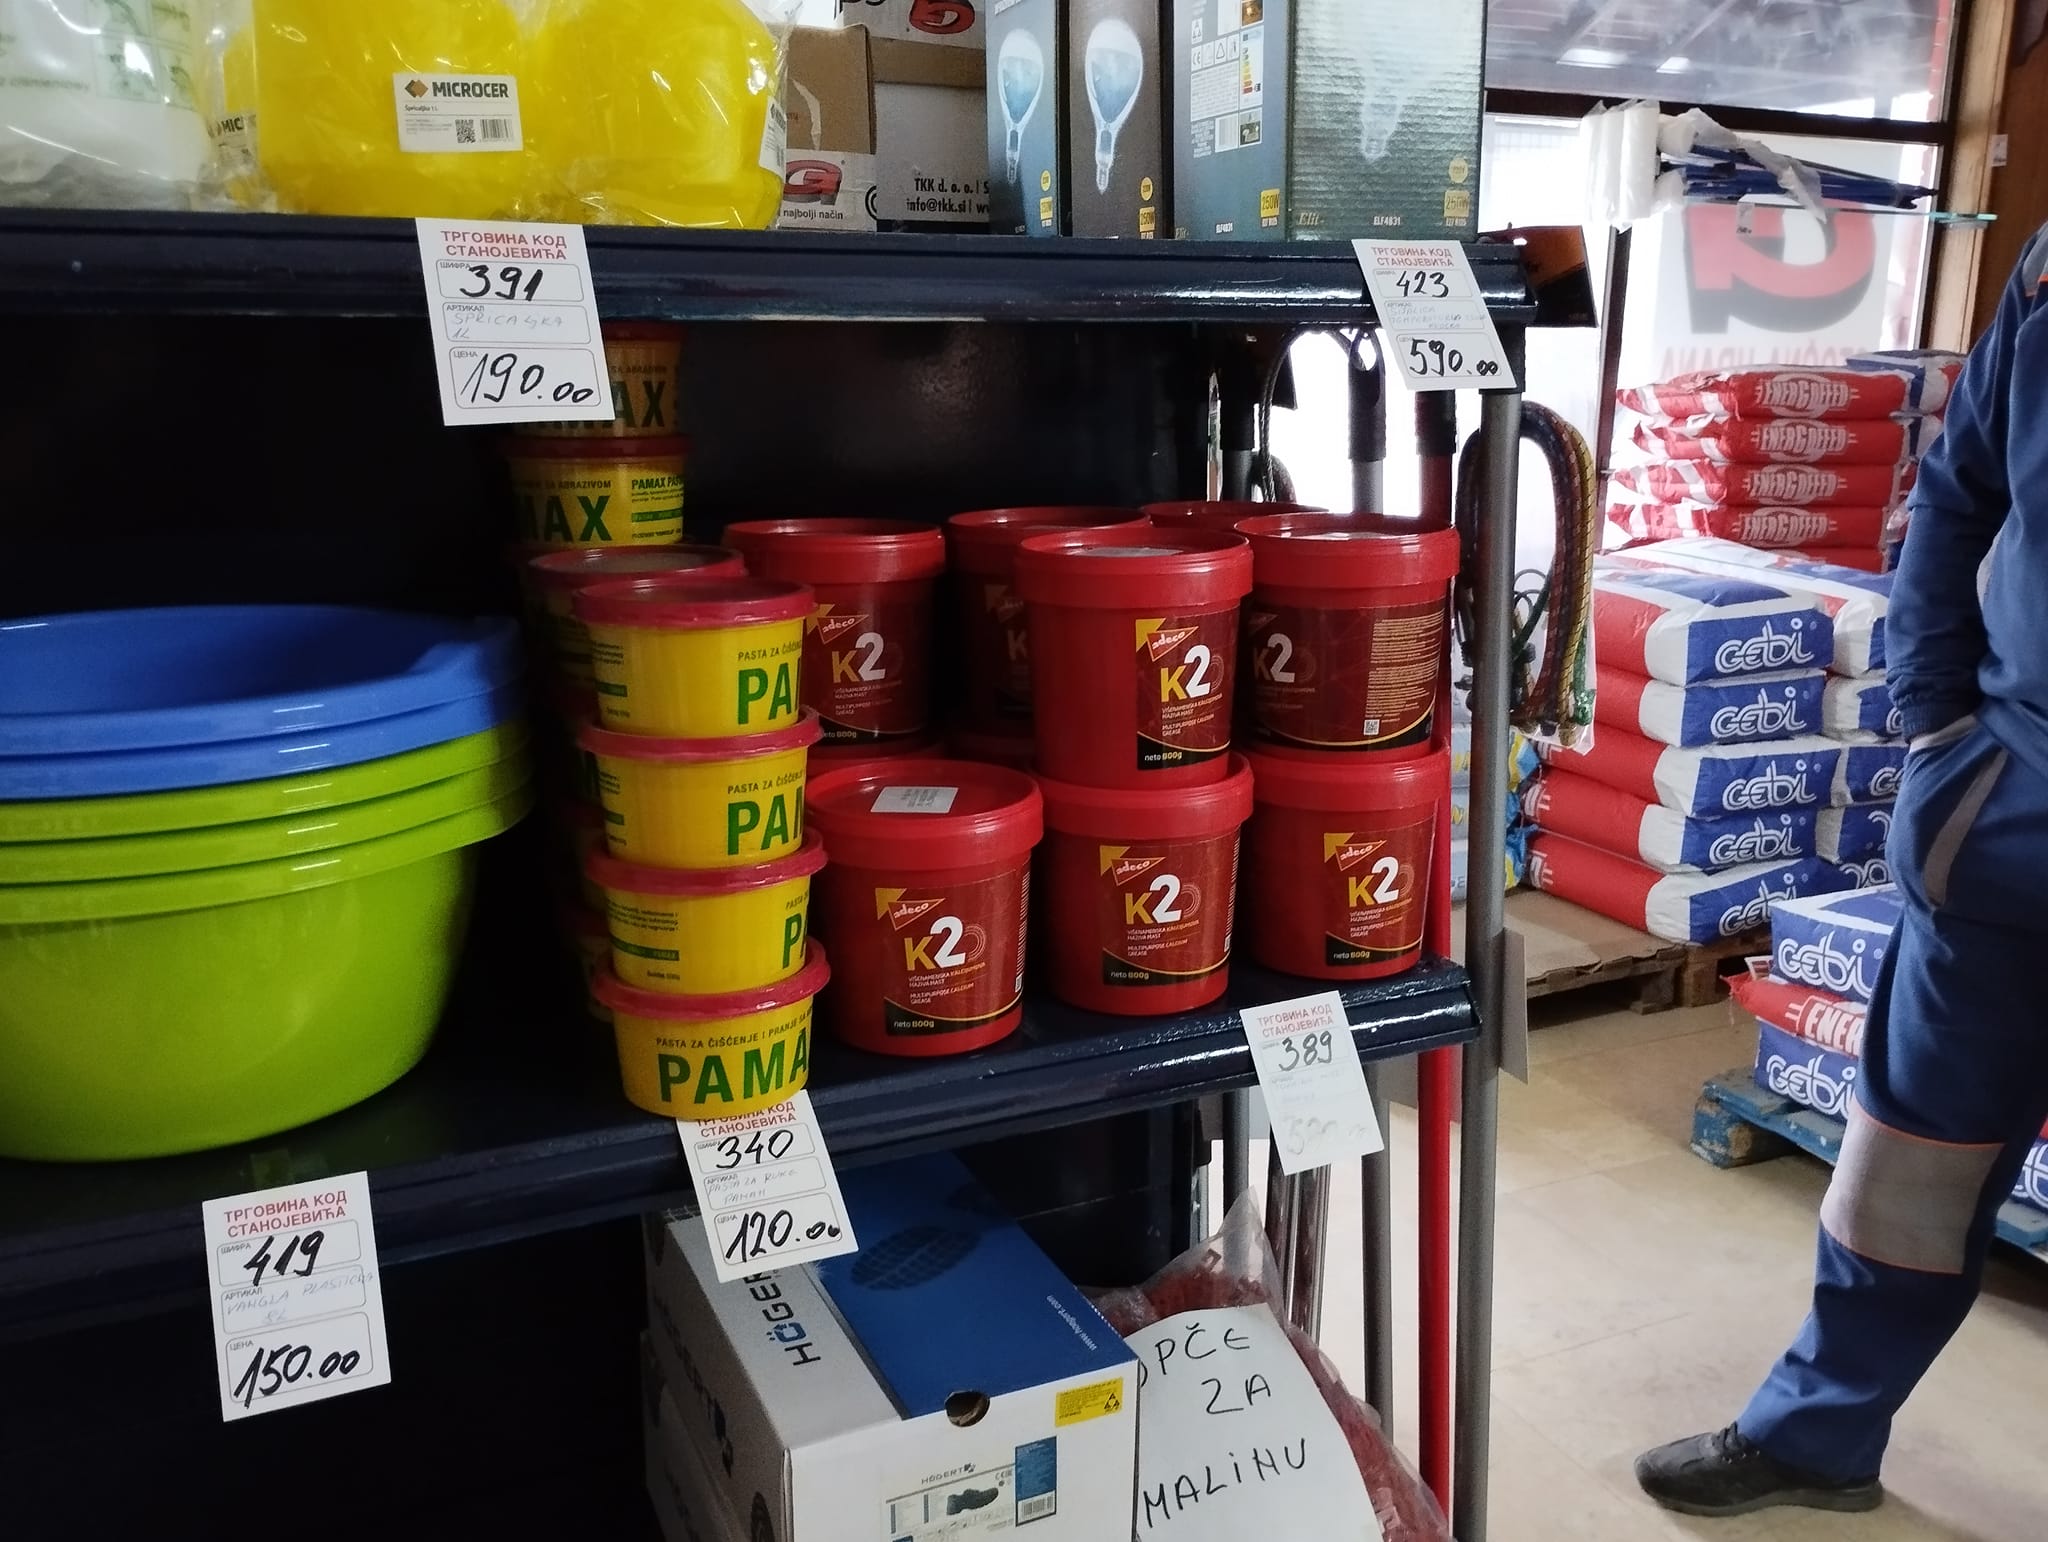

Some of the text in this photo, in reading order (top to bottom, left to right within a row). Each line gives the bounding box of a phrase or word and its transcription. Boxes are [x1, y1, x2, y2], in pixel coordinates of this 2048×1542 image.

[432, 82, 509, 97] MICROCER
[914, 178, 934, 193] TKK
[783, 210, 843, 220] najbolji način
[906, 199, 966, 214] info@tkk.si
[441, 230, 567, 248] ТРГОВИНА КОД
[446, 245, 566, 260] СТАНОЈЕВИЋА
[1371, 247, 1452, 258] ТРГОВИНА КОД
[1377, 257, 1453, 267] СТАНОЈЕВИЋА
[460, 264, 543, 301] 391
[1396, 270, 1449, 298] 423
[447, 304, 484, 312] АРТИКАЛ
[1410, 338, 1499, 377] 590.00
[460, 353, 594, 403] 190.00
[558, 480, 612, 489] ABRAZIVOM
[631, 478, 665, 489] PAMAX
[1152, 632, 1186, 650] adeco
[737, 647, 780, 662] PASTA ZA
[1160, 645, 1211, 703] K2
[1144, 753, 1162, 761] neto
[728, 782, 759, 795] PASTA
[762, 779, 773, 790] ZA
[1348, 856, 1399, 908] K2
[1125, 874, 1182, 924] K2
[894, 903, 929, 919] adeco
[904, 916, 966, 971] K2
[894, 1020, 911, 1028] neto
[1257, 1003, 1333, 1026] ТРГОВИНА КОД
[656, 1037, 686, 1048] PASTA
[691, 1039, 703, 1048] ZA
[768, 1018, 797, 1038] PRANJE
[1262, 1016, 1334, 1038] СТАНОЈЕВИЋА
[1279, 1030, 1333, 1072] 389
[767, 1101, 796, 1114] КОД
[701, 1113, 797, 1138] СТАНОЈЕВИЋА
[716, 1129, 794, 1169] 340
[224, 1190, 348, 1223] ТРГОВИНА КОД
[227, 1206, 346, 1238] СТАНОЈЕВИЋА
[725, 1210, 842, 1263] 120.00
[244, 1230, 325, 1287] 419
[225, 1287, 263, 1301] АРТИКАЛ
[229, 1340, 255, 1351] ЦЕНА
[233, 1344, 361, 1409] 150.00
[1201, 1374, 1272, 1414] ZA
